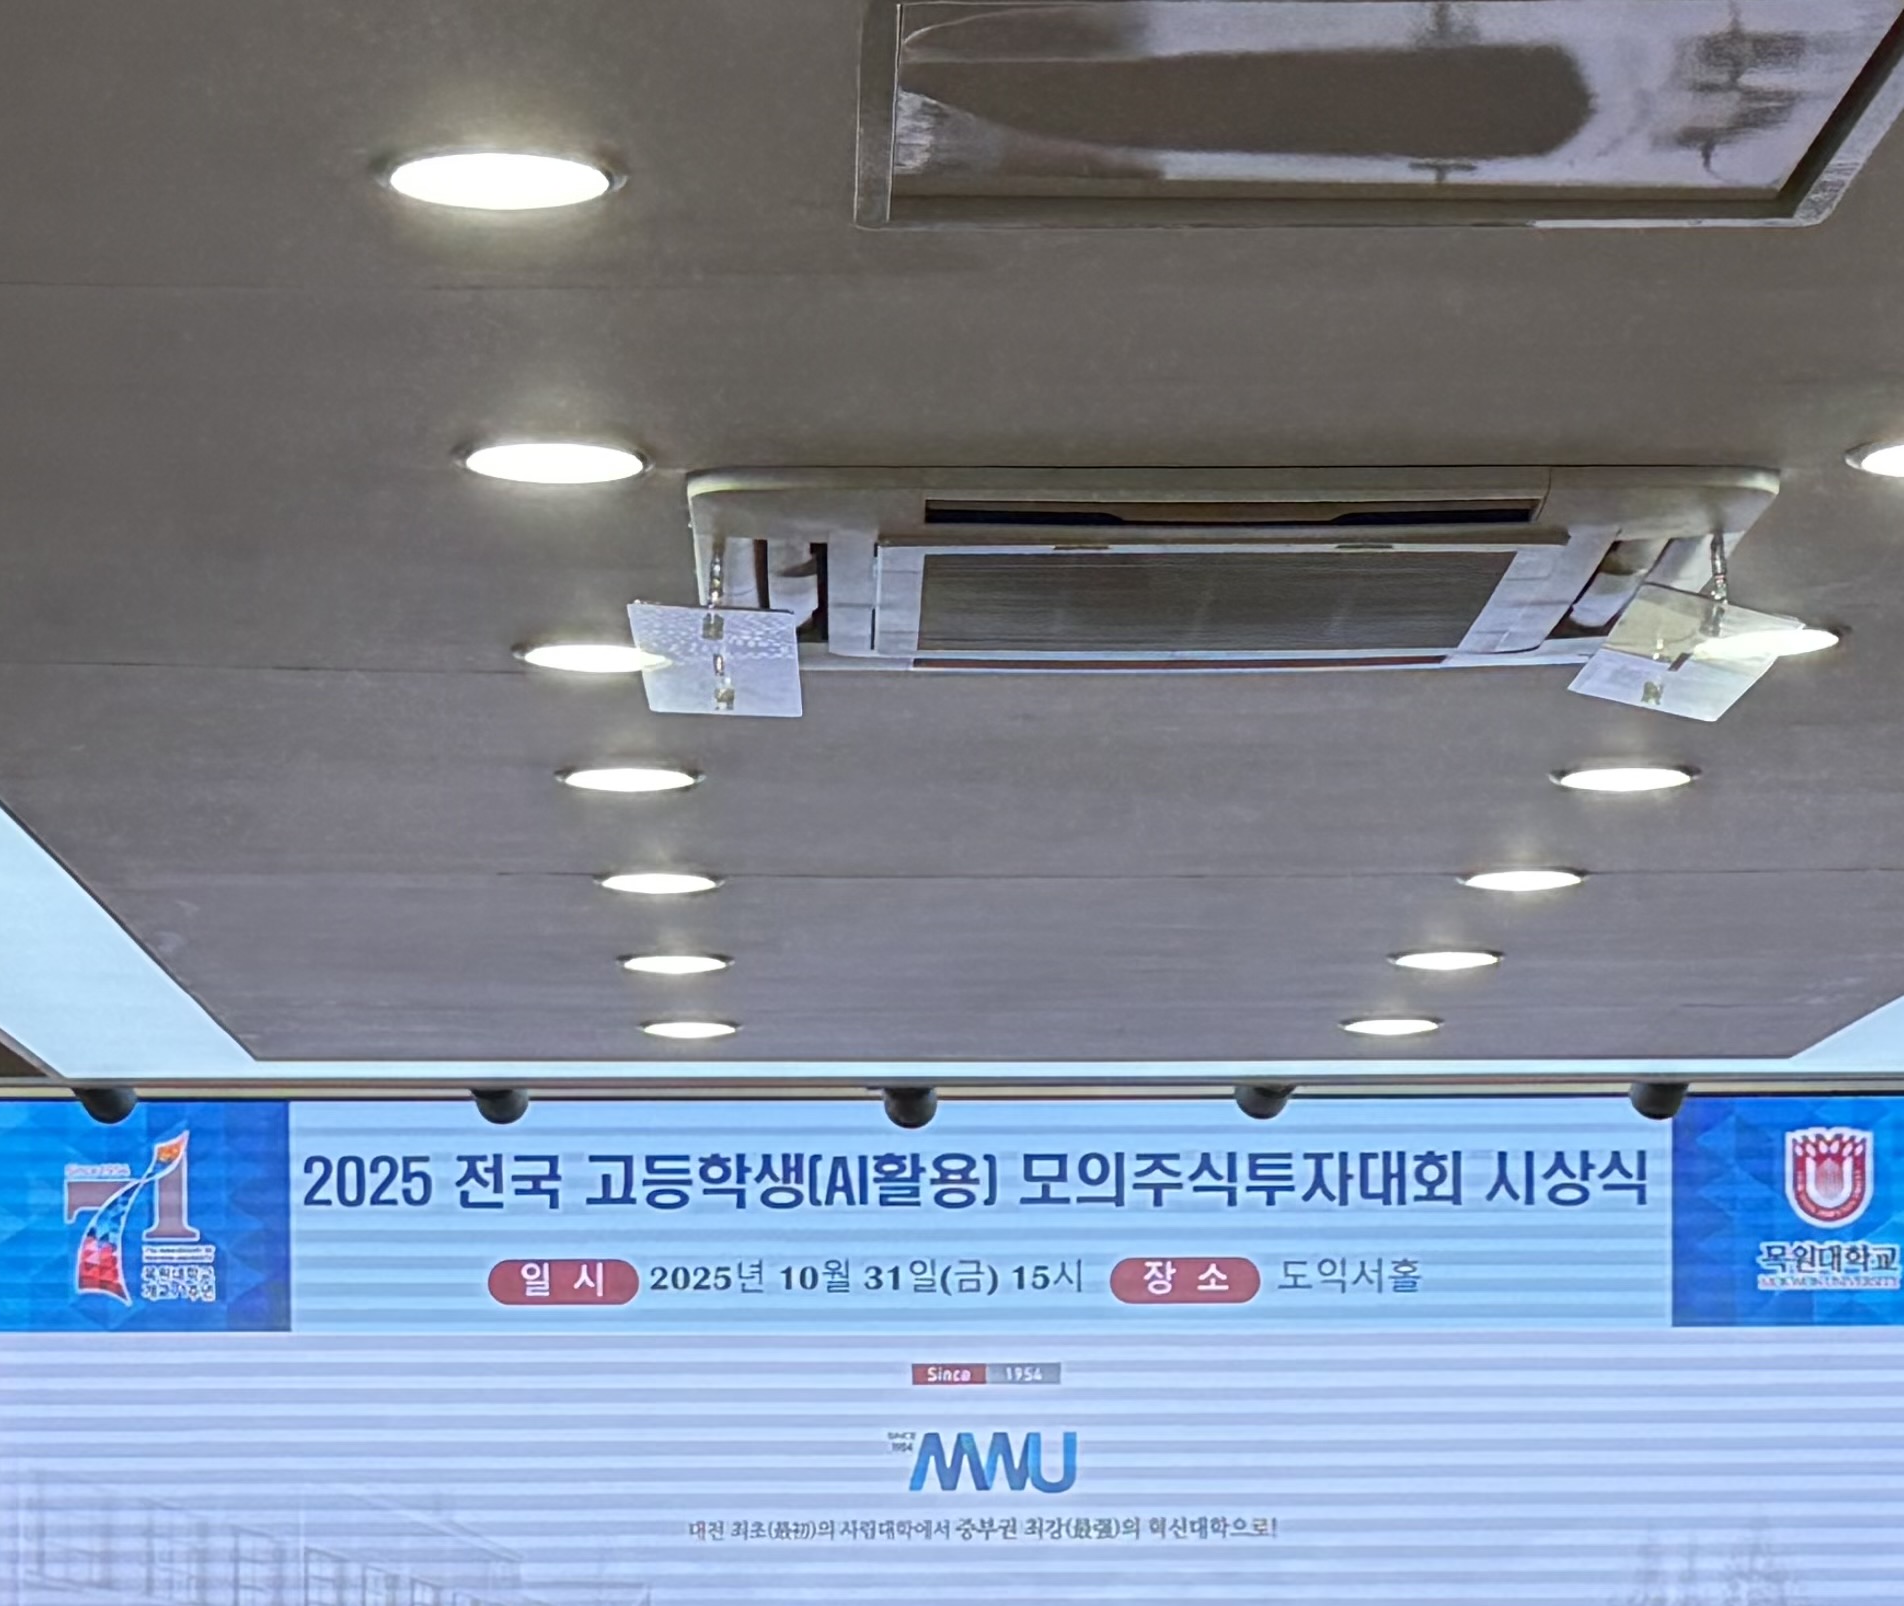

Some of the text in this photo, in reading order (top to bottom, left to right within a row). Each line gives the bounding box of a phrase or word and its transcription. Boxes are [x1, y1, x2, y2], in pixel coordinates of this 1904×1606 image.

[303, 1154, 433, 1207] 2025
[454, 1152, 563, 1210] 전국
[1019, 1150, 1463, 1208] 모의주식투자대회
[1485, 1150, 1648, 1207] 시상식
[1761, 1243, 1899, 1273] 목원대학교
[649, 1258, 764, 1294] 2025년
[780, 1257, 851, 1294] 10월
[864, 1258, 999, 1297] 31일(금)
[1012, 1258, 1083, 1294] 15시
[1277, 1257, 1422, 1294] 도익서홀
[927, 1366, 1043, 1383] Since 1954
[687, 1519, 725, 1541] 대전
[954, 1517, 1018, 1541] 중부권
